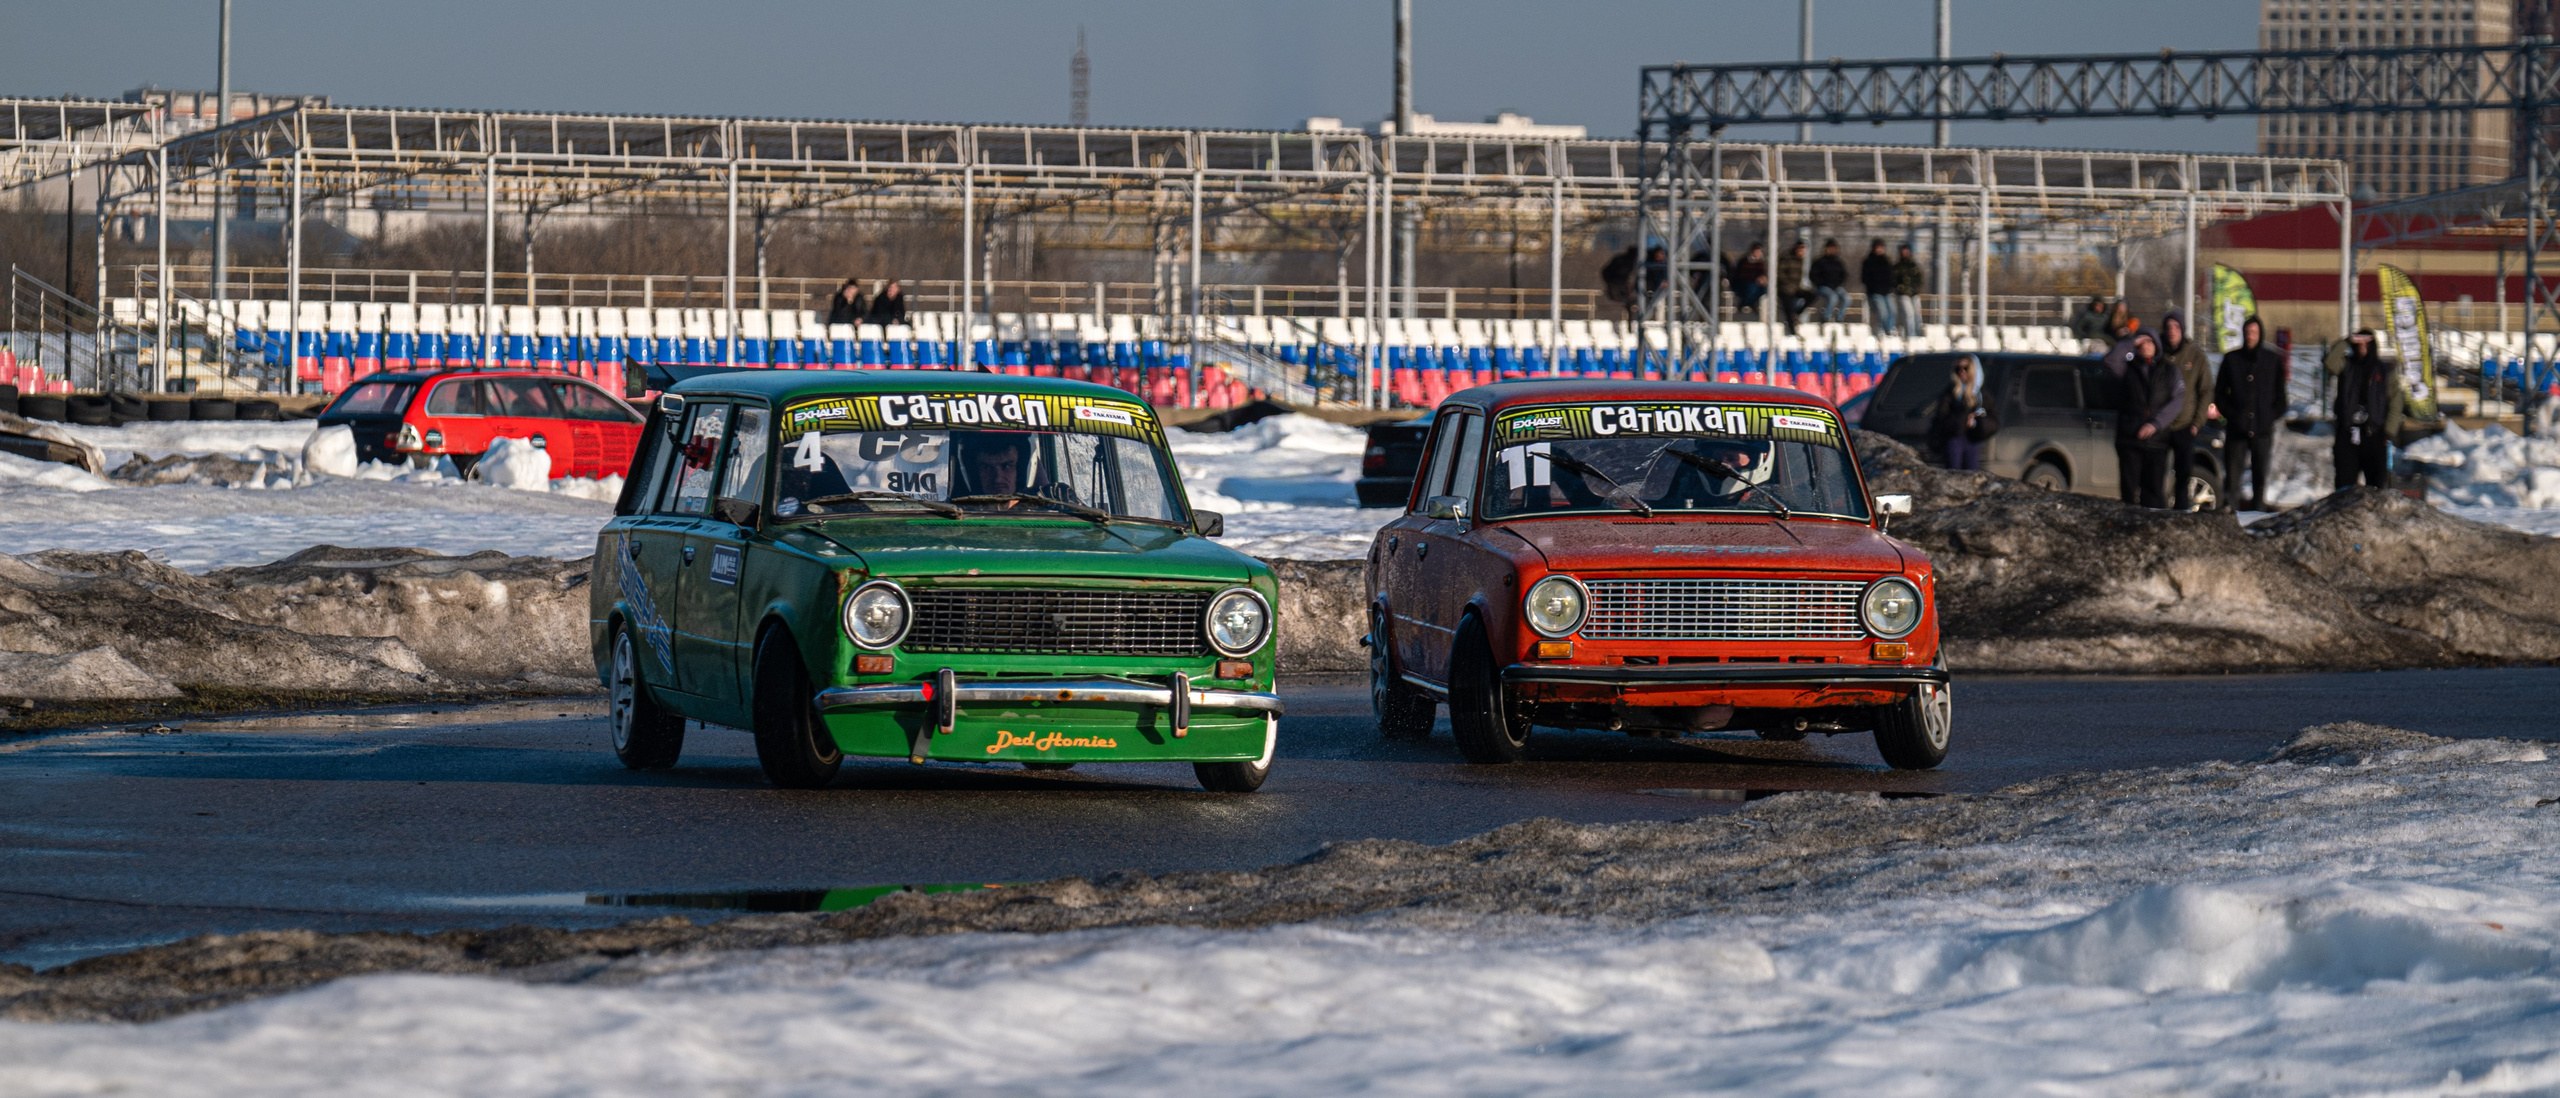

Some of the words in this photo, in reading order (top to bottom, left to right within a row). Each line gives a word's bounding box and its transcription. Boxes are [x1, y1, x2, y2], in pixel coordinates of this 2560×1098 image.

[794, 407, 849, 422] EXHAUST
[1093, 412, 1126, 421] TAKAYAMA
[1513, 416, 1563, 430] EXHAUST
[793, 430, 825, 472] 4
[1500, 443, 1551, 490] 11
[986, 731, 1035, 754] Ded
[1035, 731, 1117, 751] Homies
